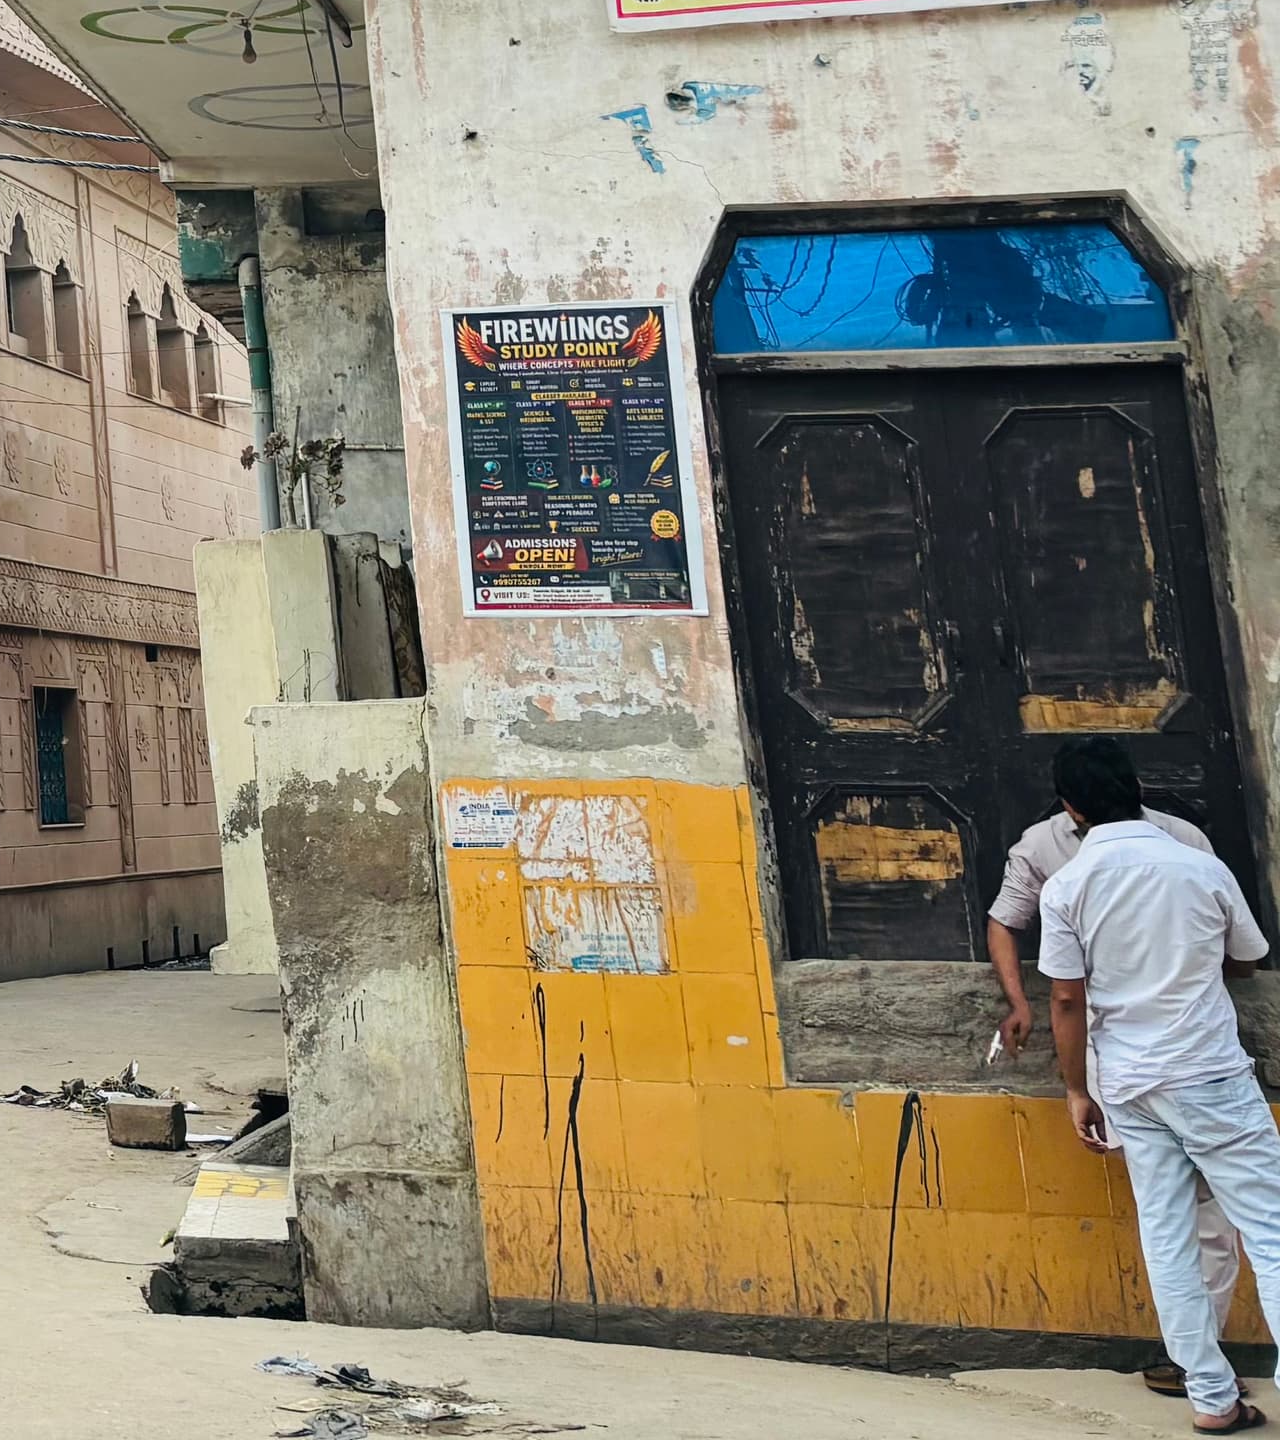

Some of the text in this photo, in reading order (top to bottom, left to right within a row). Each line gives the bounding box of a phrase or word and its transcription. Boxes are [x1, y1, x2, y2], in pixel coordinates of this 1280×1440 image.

[500, 342, 620, 360] STUDY POINT
[498, 358, 627, 371] WHERE CONCEPTS TAKE FLIGHT
[505, 538, 577, 549] ADMISSIONS
[515, 548, 576, 562] OPEN!
